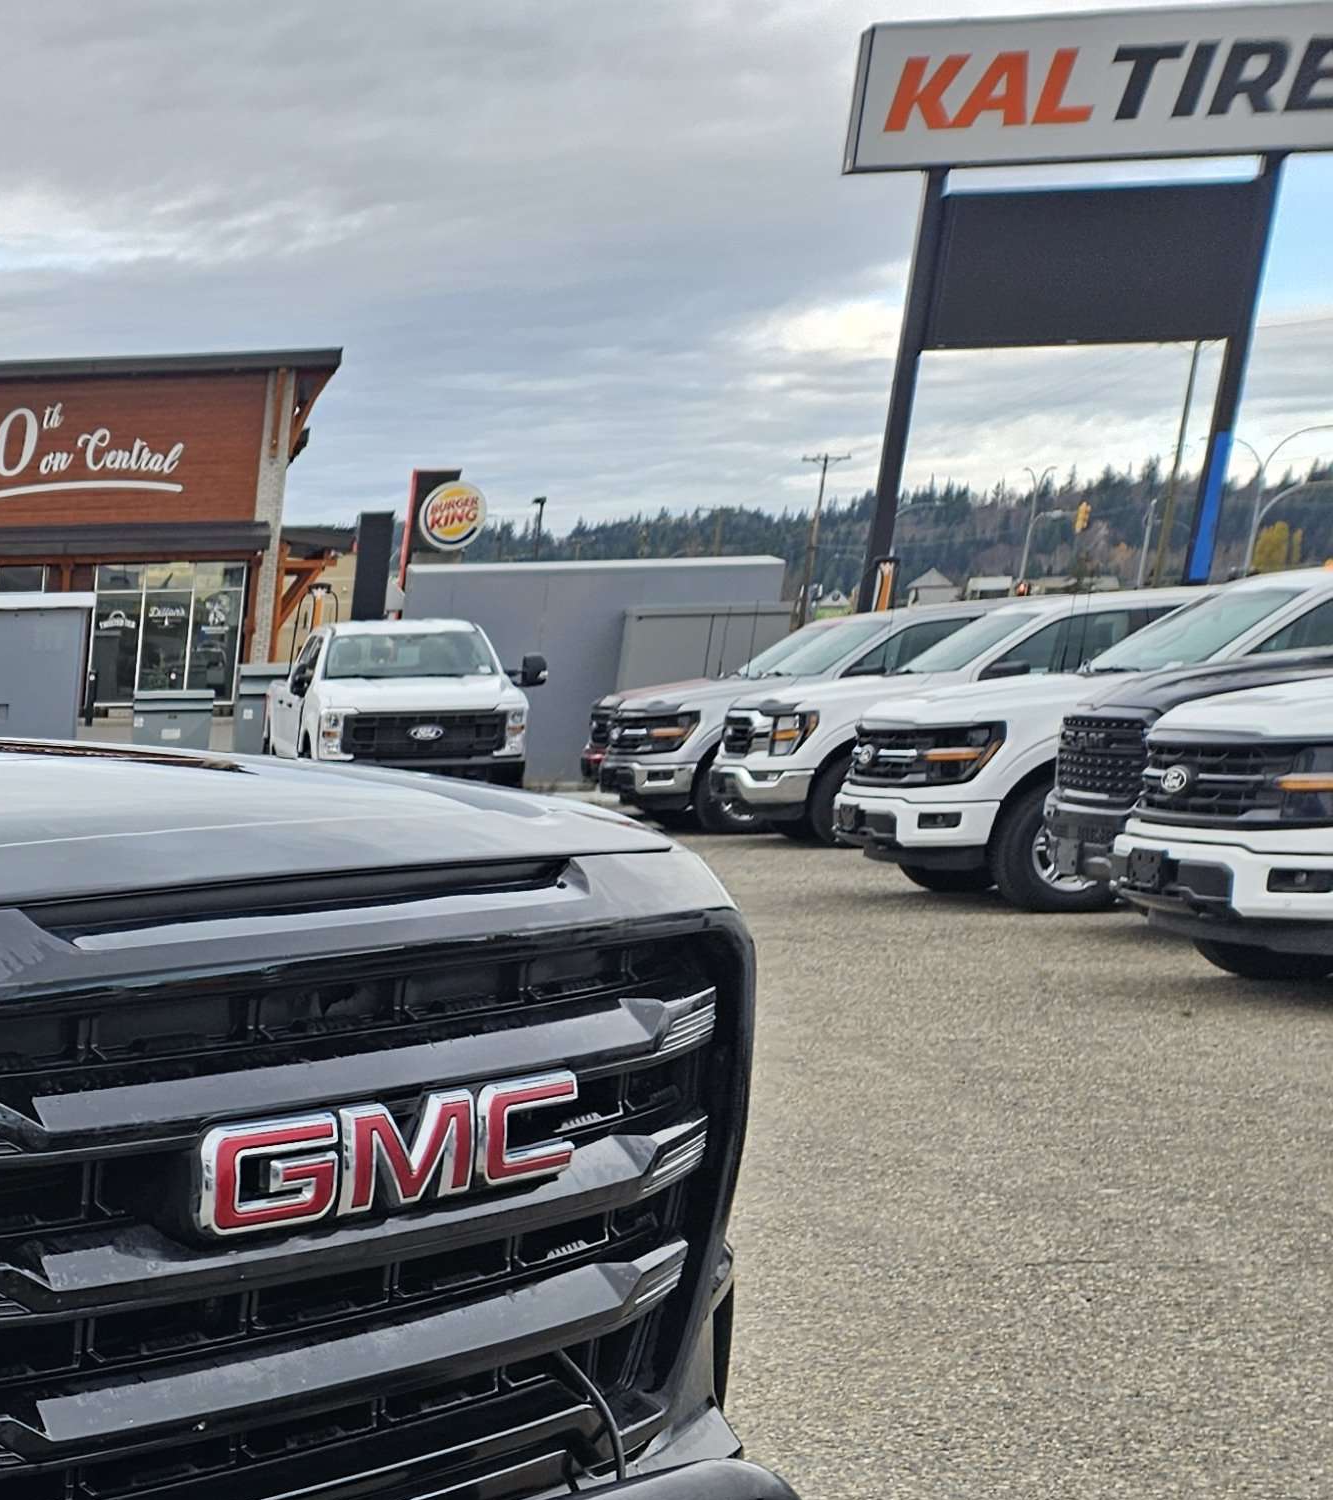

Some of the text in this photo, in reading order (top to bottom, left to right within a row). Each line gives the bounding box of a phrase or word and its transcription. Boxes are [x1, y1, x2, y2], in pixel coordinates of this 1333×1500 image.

[883, 48, 1095, 133] KAL
[39, 451, 74, 474] on
[77, 428, 184, 474] Central
[429, 509, 477, 530] KING
[430, 496, 479, 514] BURGER
[200, 1070, 577, 1236] GMC
